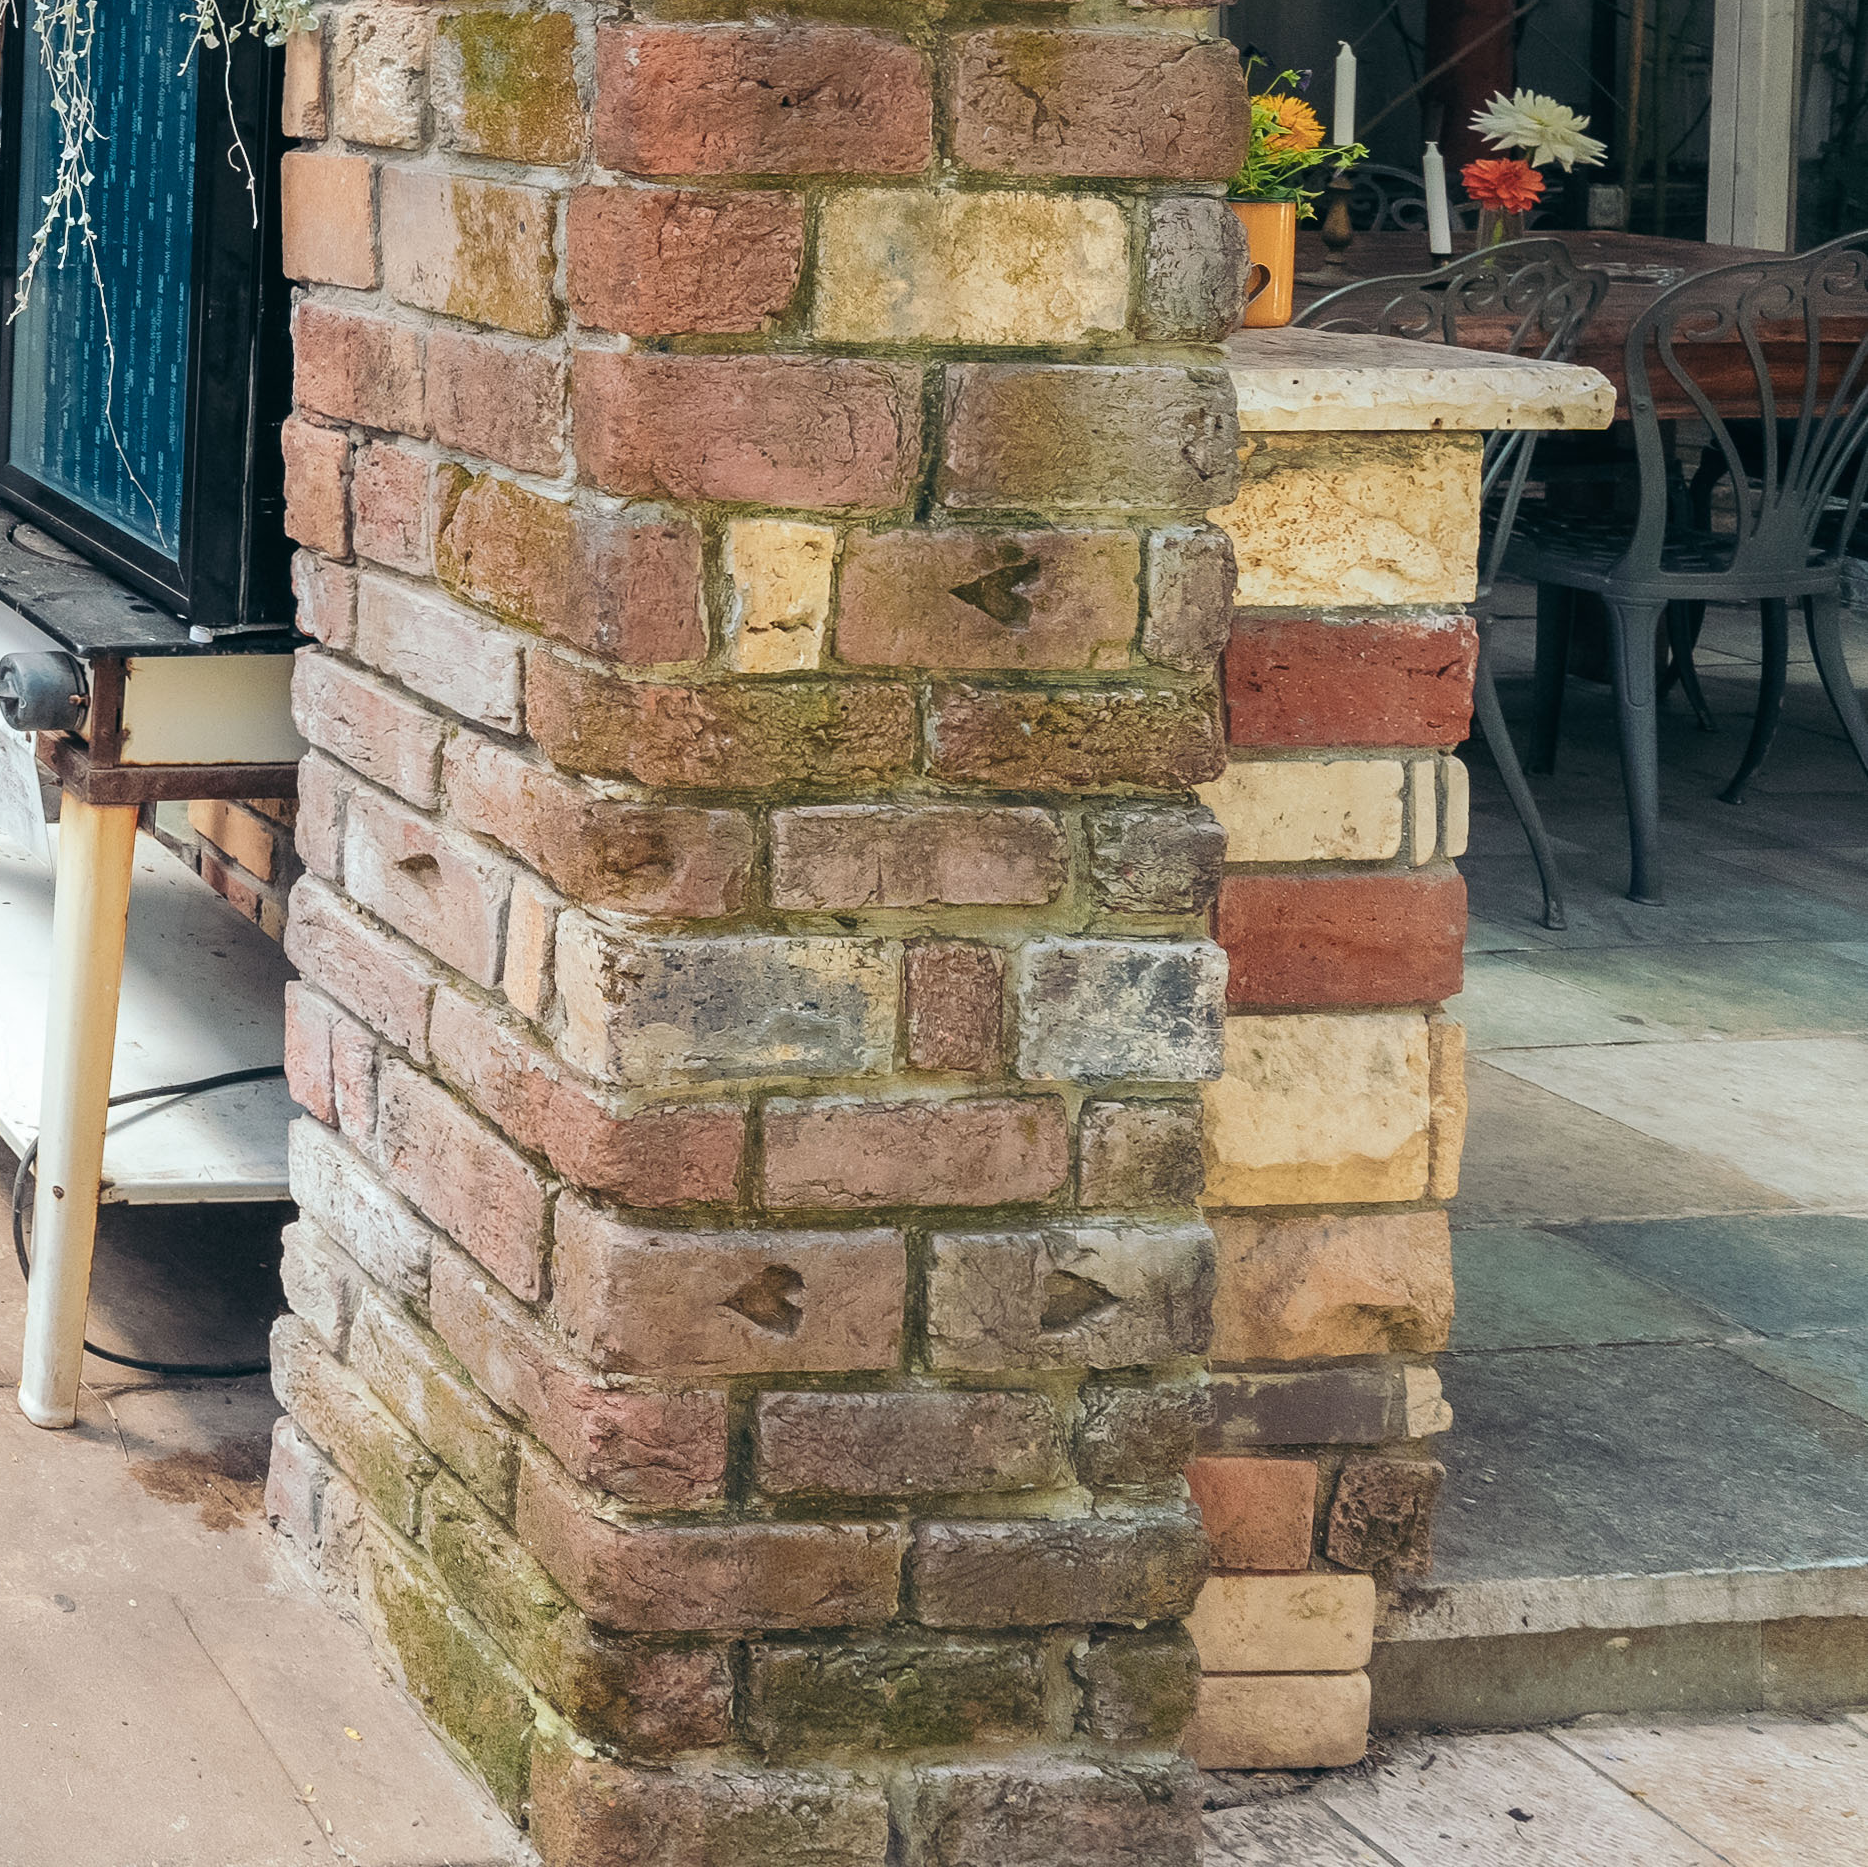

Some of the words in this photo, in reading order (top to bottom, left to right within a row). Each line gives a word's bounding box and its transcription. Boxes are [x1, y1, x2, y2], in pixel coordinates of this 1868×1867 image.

[118, 25, 126, 82] Safety-Walk
[145, 35, 152, 54] 3M
[165, 27, 173, 85] Safety-Walk
[118, 85, 124, 103] 3M
[157, 60, 165, 118] Safety-Walk
[179, 91, 187, 111] 3M
[137, 116, 144, 135] 3M
[156, 121, 163, 140] 3M
[130, 110, 138, 166] Safety-Walk
[178, 114, 186, 172] Safety-Walk
[189, 141, 196, 163] 3M
[130, 169, 136, 188] 3M
[149, 141, 157, 198] Safety-Walk
[148, 201, 155, 221] 3M
[166, 193, 173, 213] 3M
[122, 189, 130, 245] Safety-Walk
[164, 215, 172, 273] Safety-Walk
[121, 248, 128, 268] 3M
[136, 229, 144, 287] Safety-Walk
[157, 274, 164, 294] 3M
[135, 289, 142, 309] 3M
[155, 296, 163, 353] Safety-Walk
[170, 363, 177, 384] 3M
[148, 376, 155, 396] 3M
[168, 386, 176, 444] Safety-Walk
[157, 451, 164, 471] 3M
